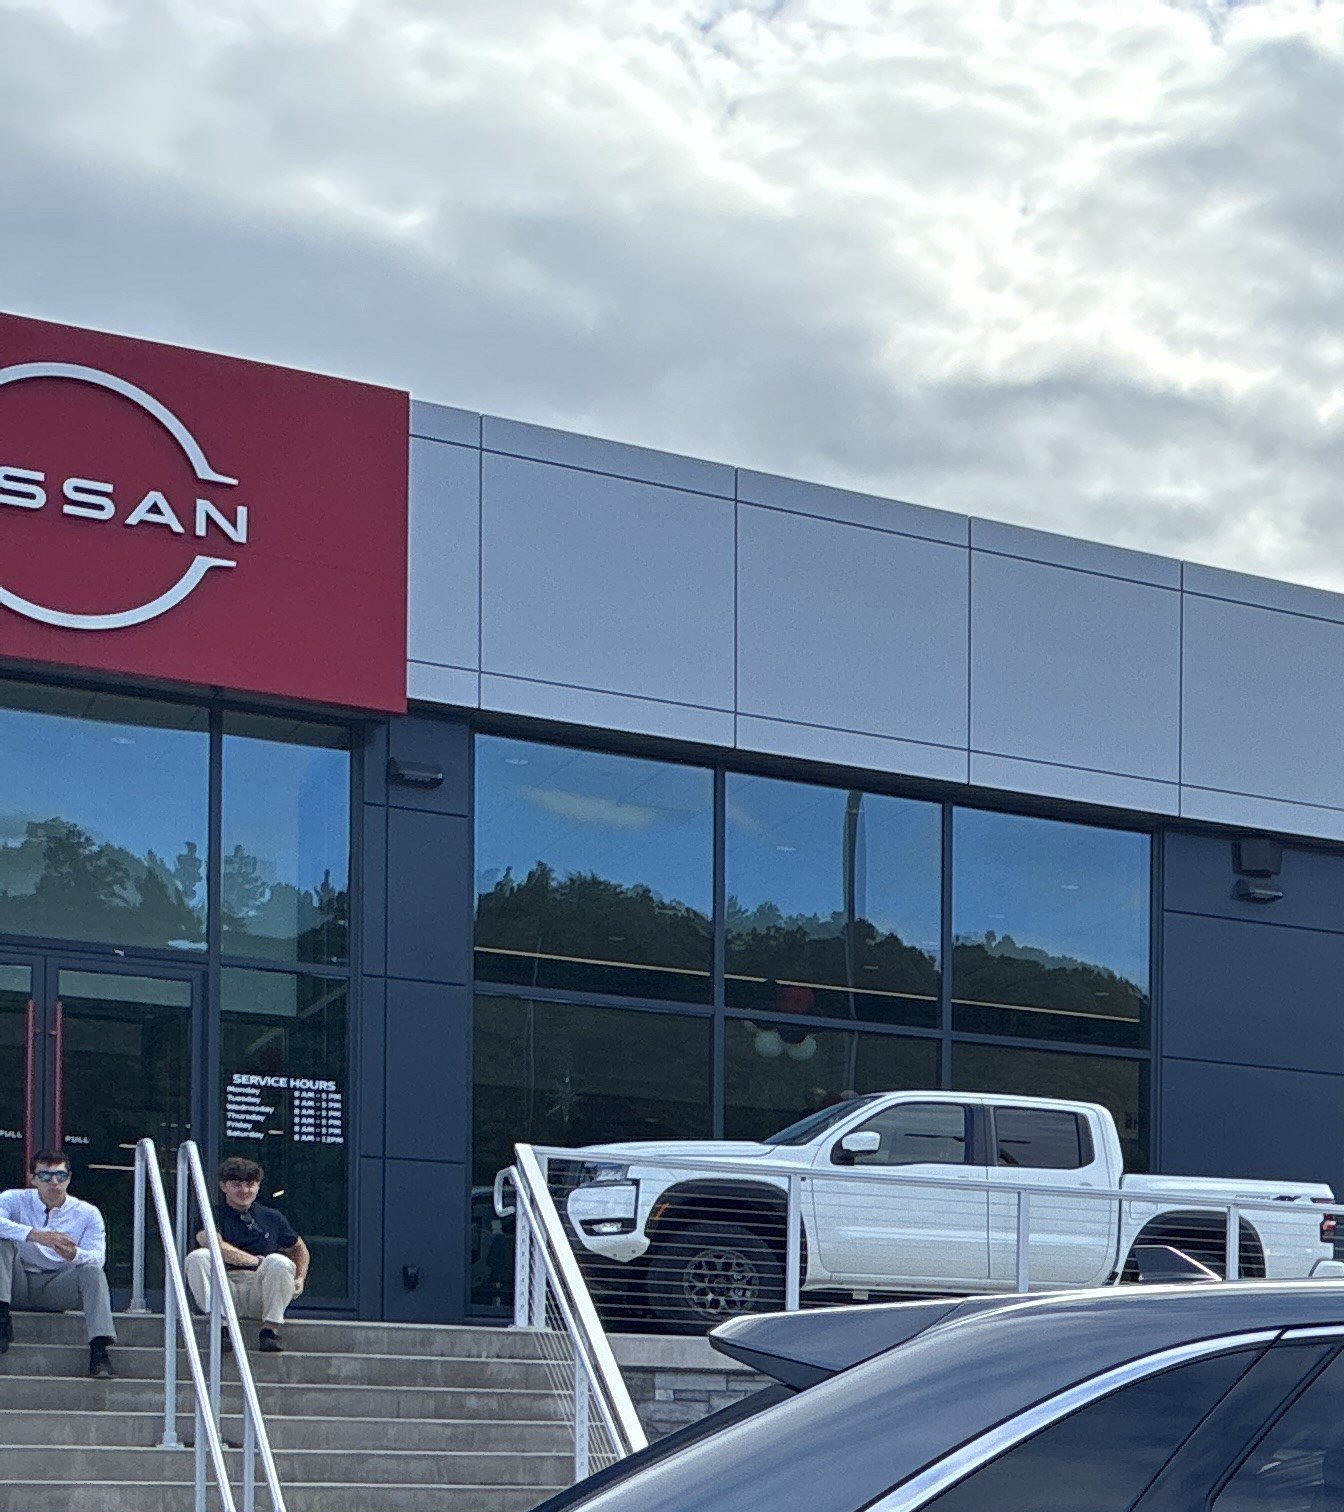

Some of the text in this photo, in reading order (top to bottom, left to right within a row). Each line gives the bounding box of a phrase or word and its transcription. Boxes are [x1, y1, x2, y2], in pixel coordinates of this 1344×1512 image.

[0, 465, 248, 544] SSAN
[232, 1073, 337, 1092] SERVICE HOURS
